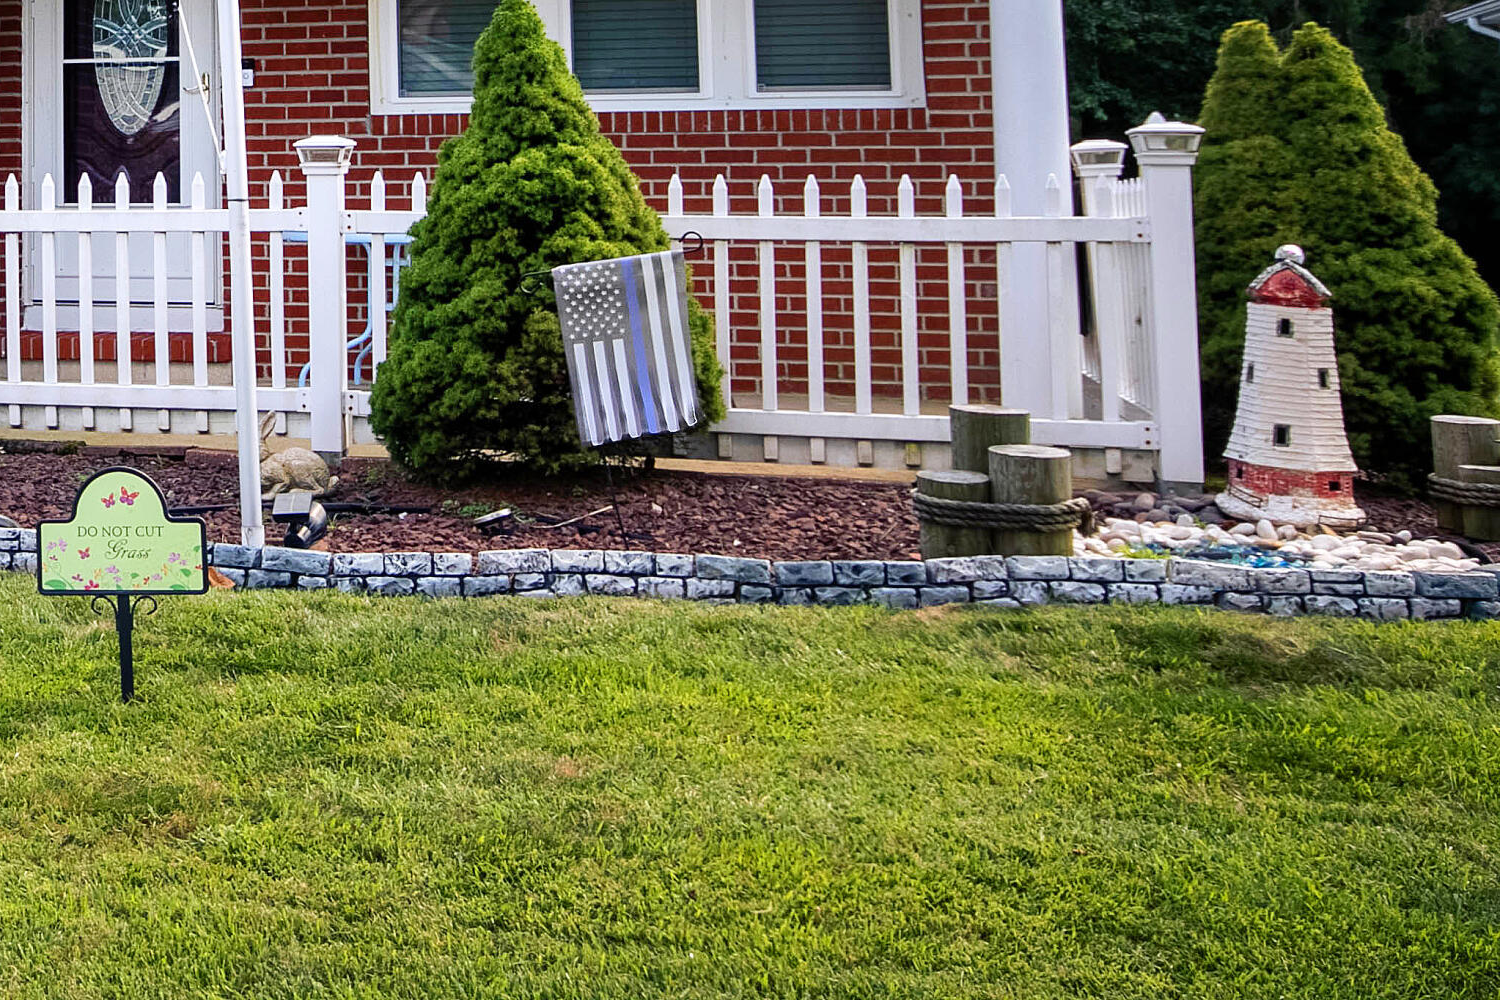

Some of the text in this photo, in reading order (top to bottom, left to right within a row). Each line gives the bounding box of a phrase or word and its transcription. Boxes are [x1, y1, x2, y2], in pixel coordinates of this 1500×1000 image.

[77, 526, 164, 537] DO NOT CUT
[105, 539, 152, 560] Grass
